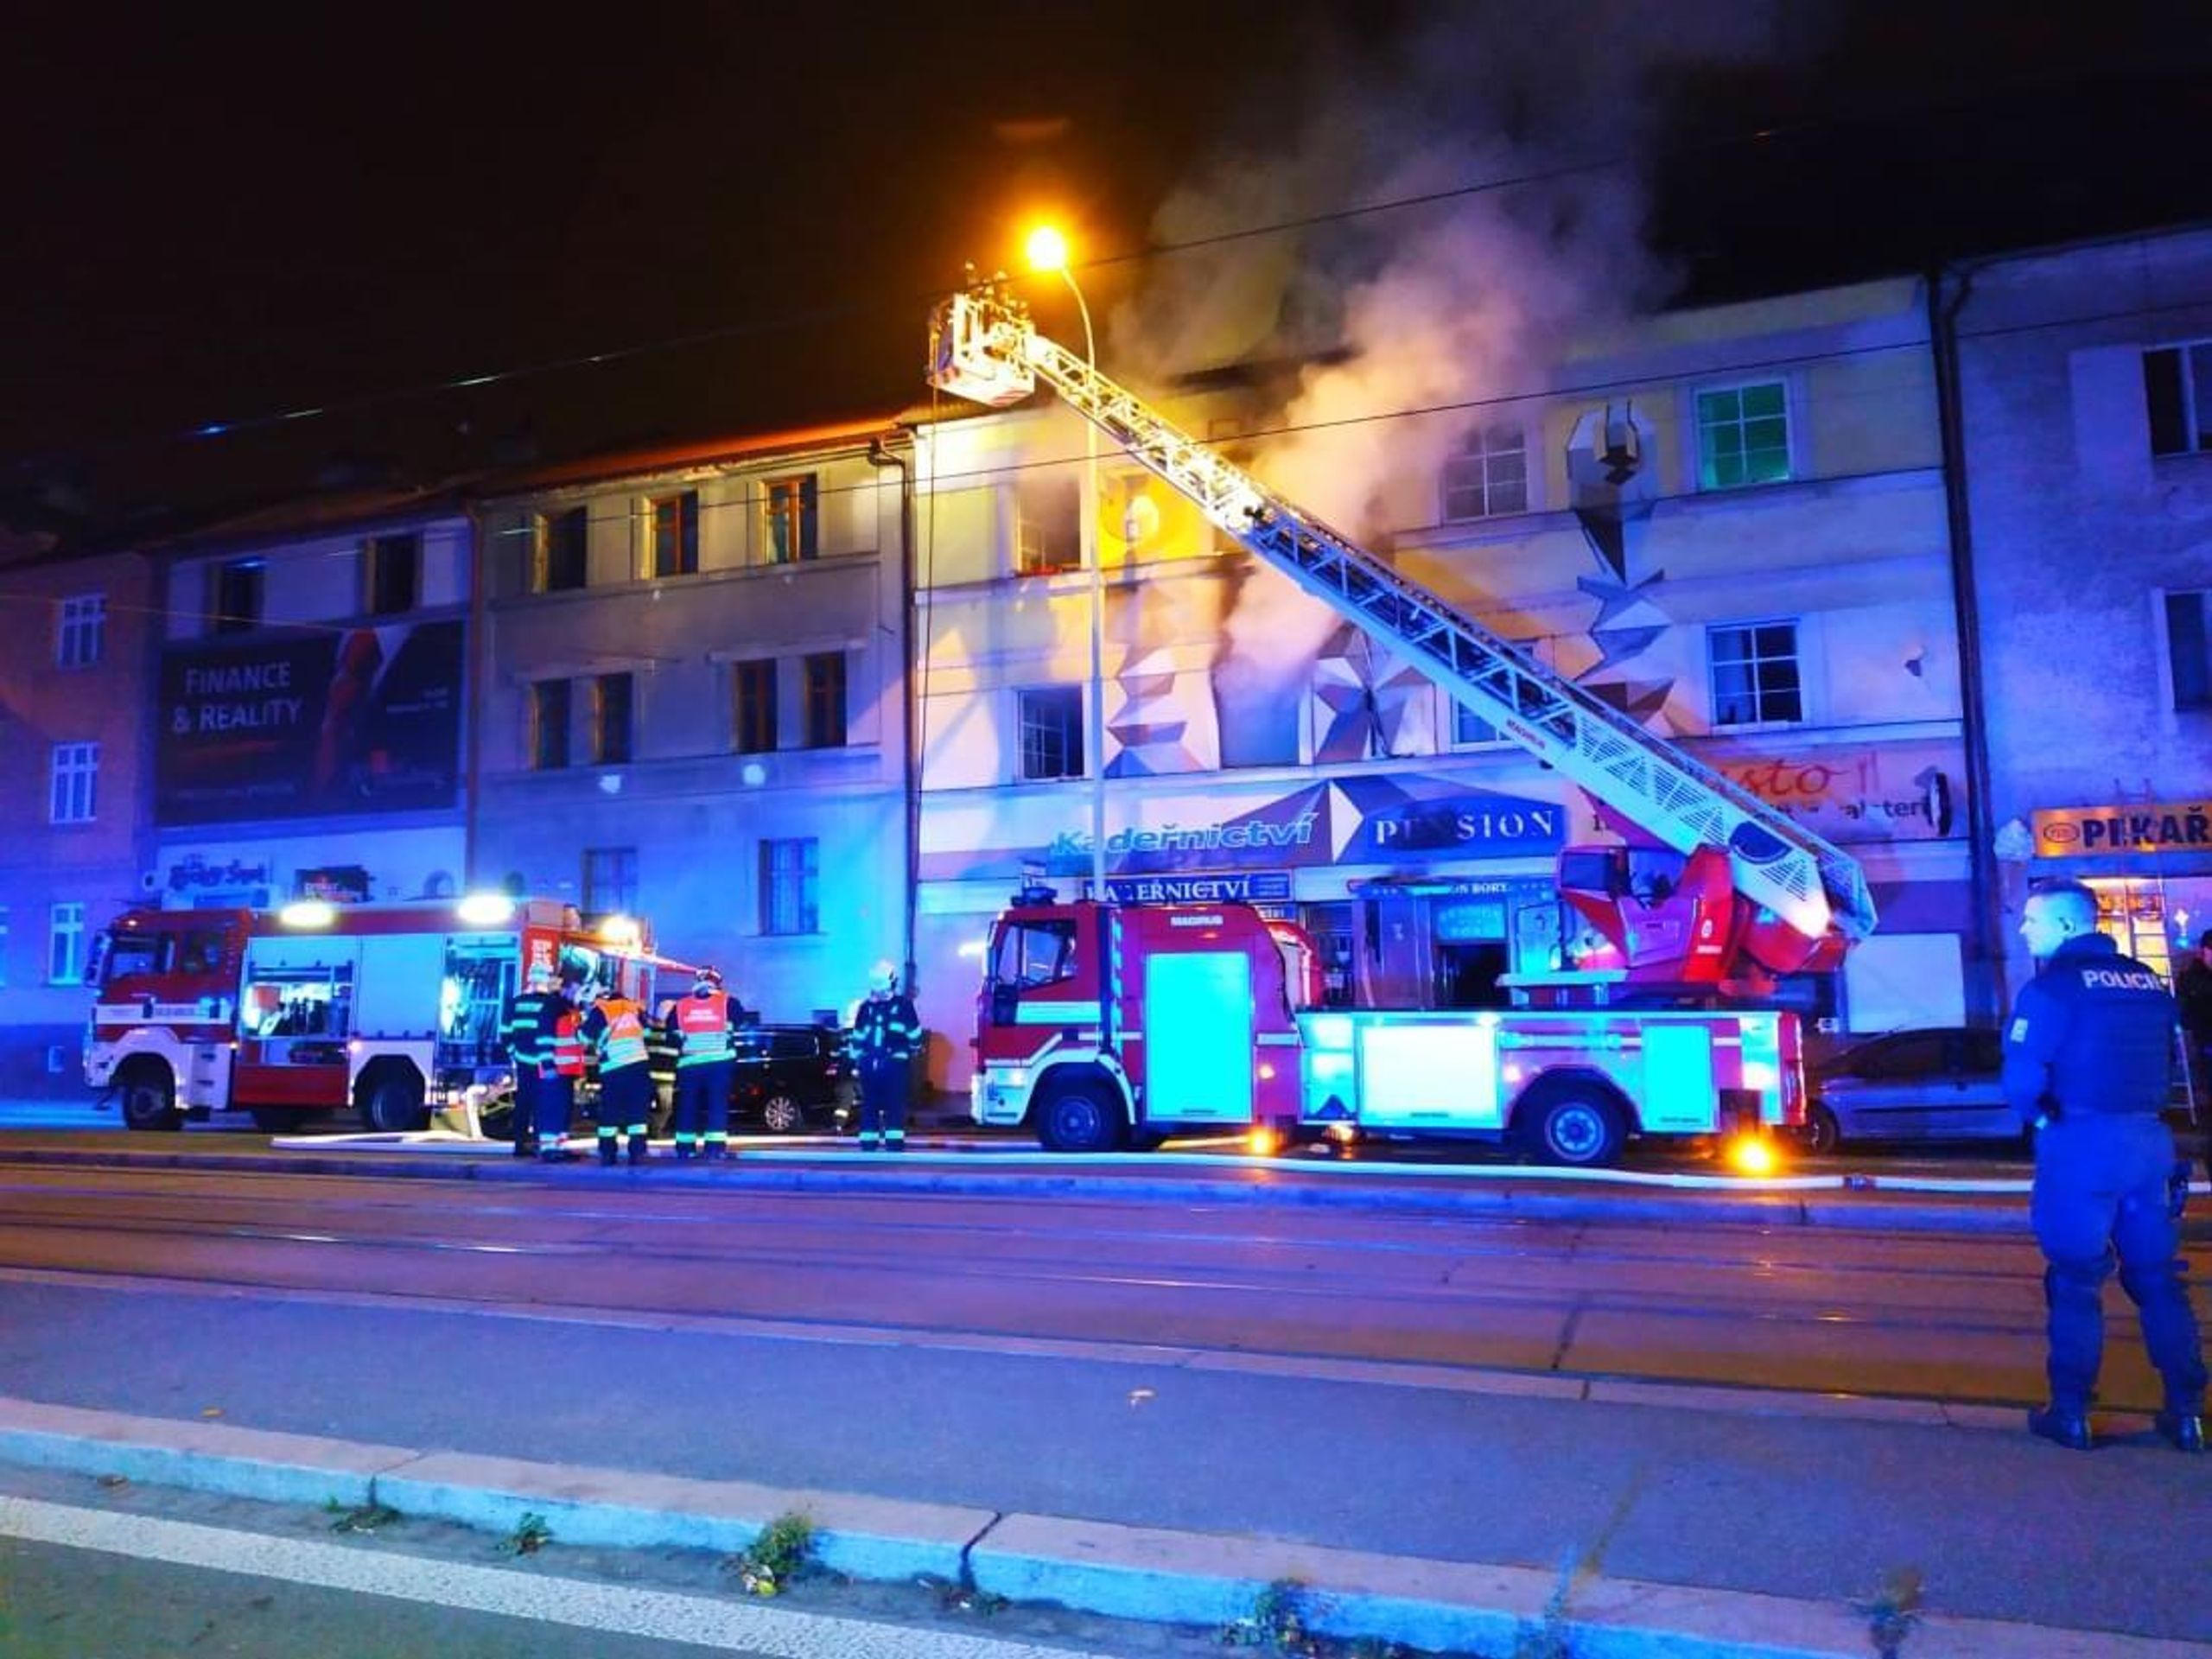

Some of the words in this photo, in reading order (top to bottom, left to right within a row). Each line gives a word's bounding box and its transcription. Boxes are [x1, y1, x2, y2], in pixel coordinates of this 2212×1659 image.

[185, 661, 291, 693] FINANCE
[174, 707, 191, 734] &
[200, 697, 302, 731] REALITY
[1052, 811, 1320, 856] Kadeřnictví
[1376, 810, 1554, 845] PSION
[1085, 874, 1251, 902] AEŘNICTVÍ
